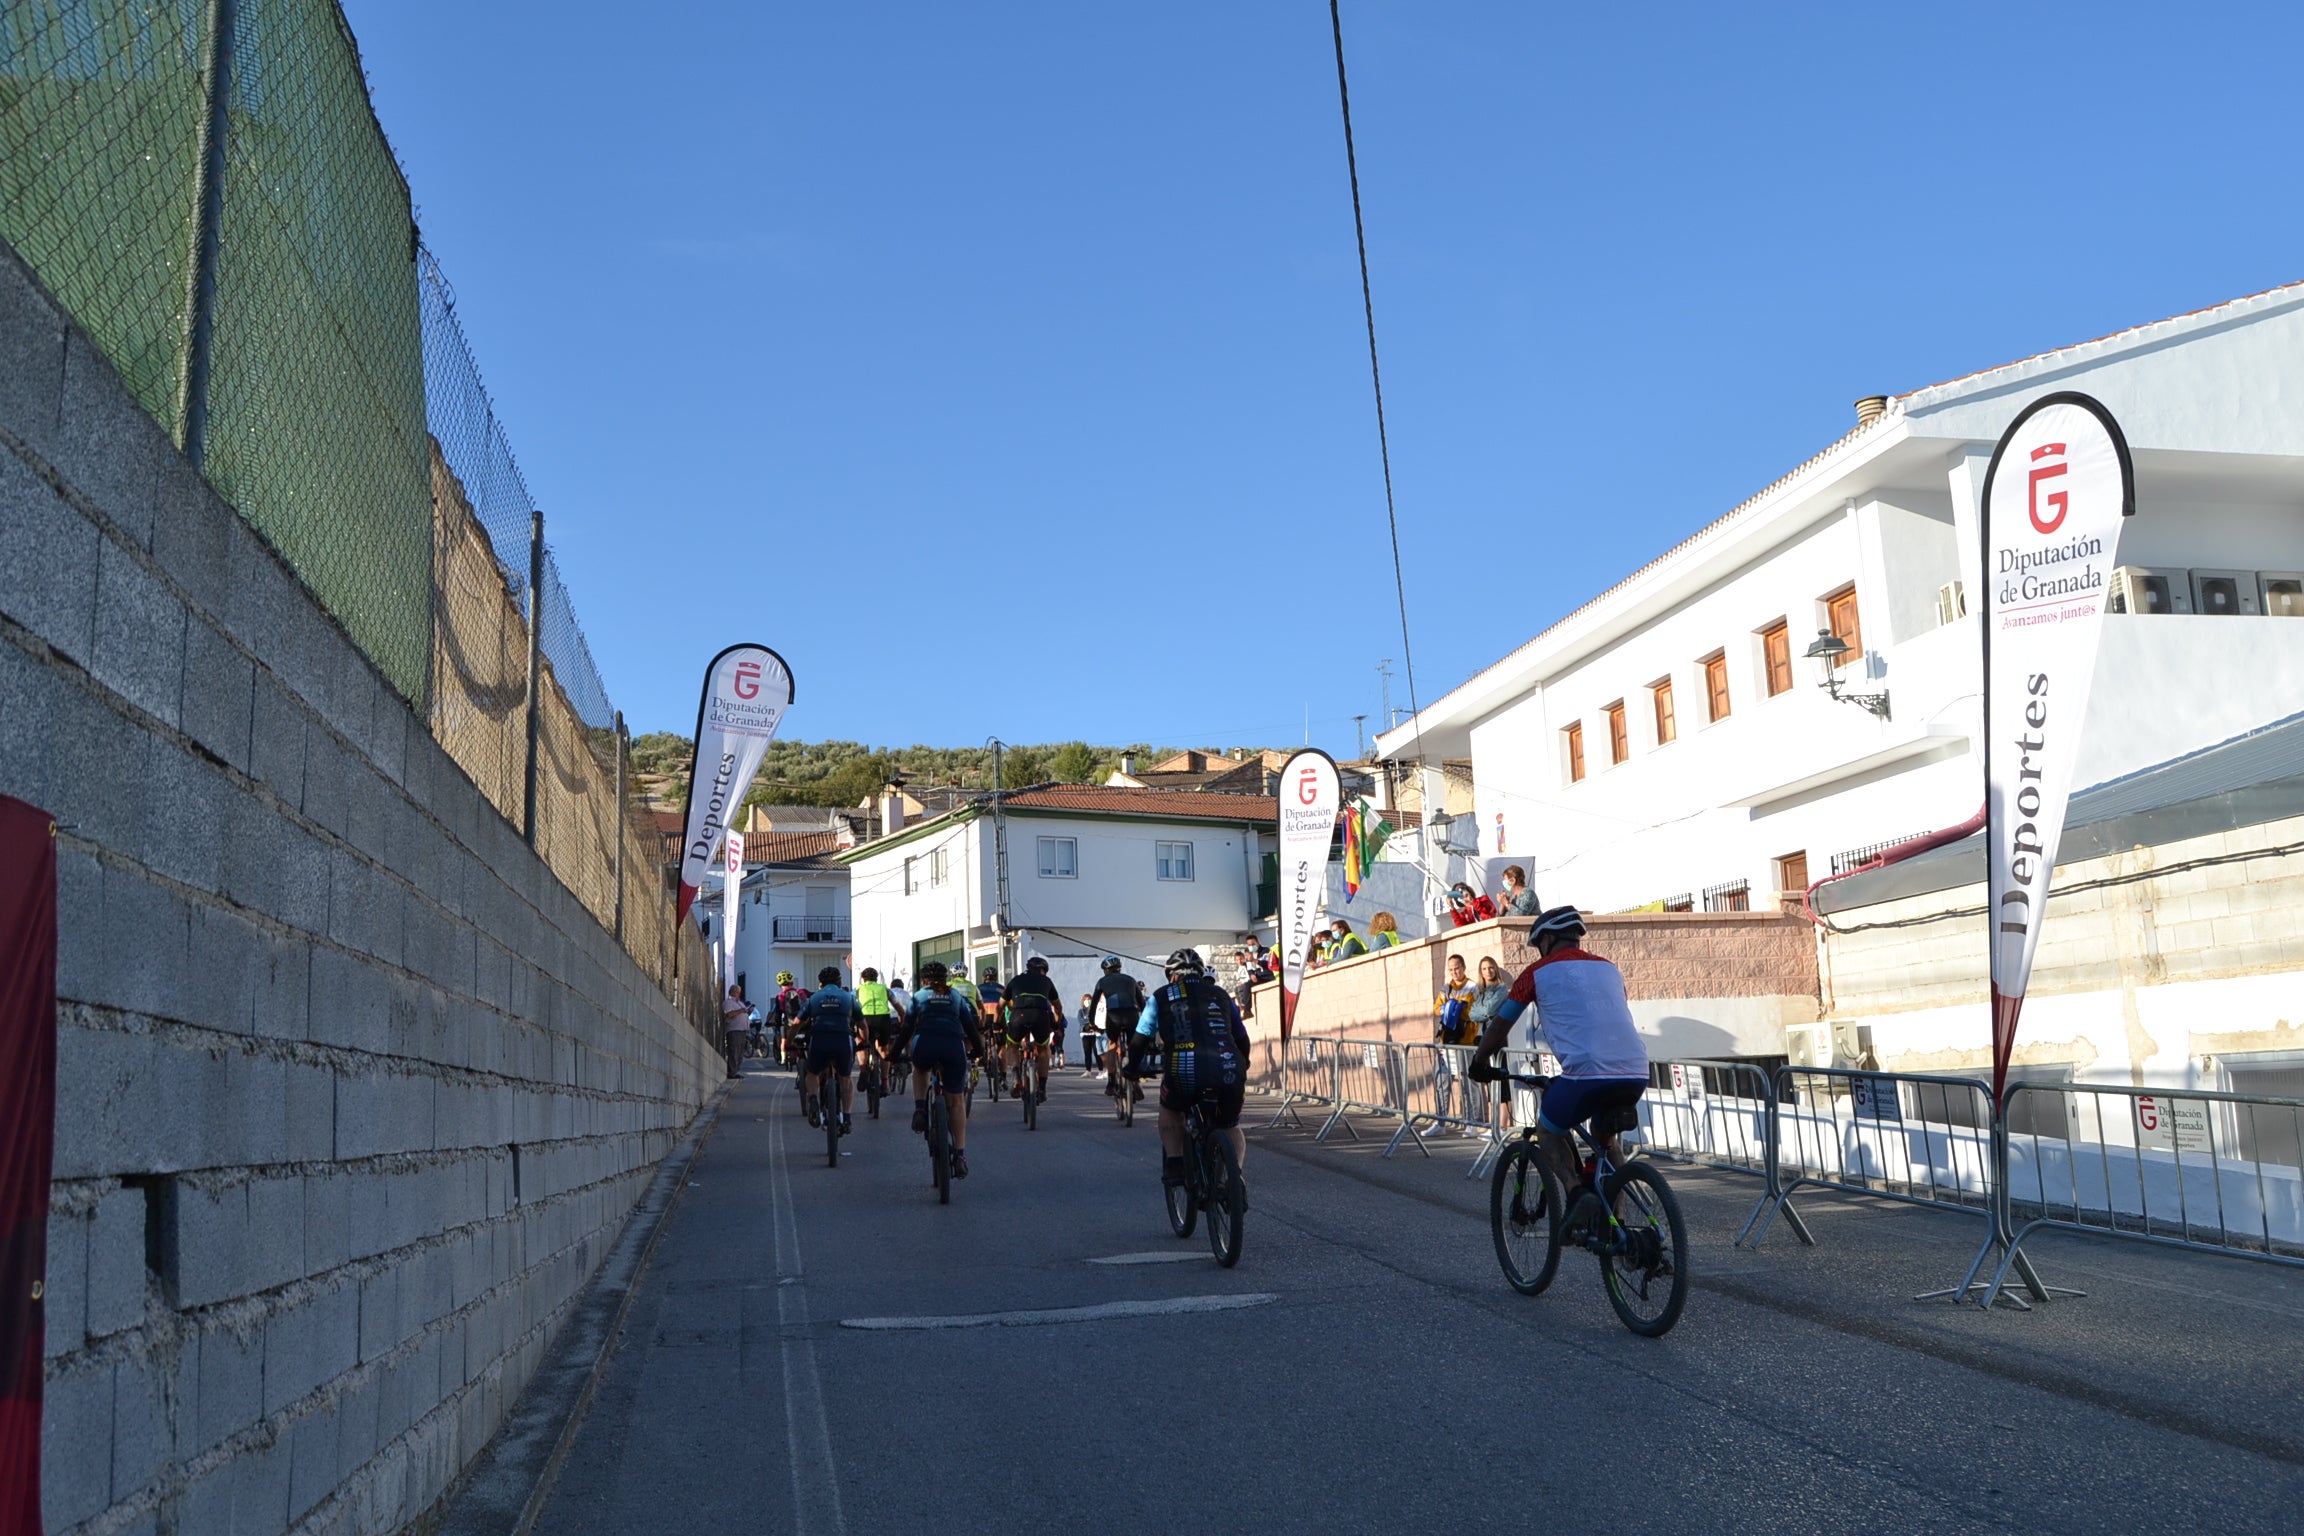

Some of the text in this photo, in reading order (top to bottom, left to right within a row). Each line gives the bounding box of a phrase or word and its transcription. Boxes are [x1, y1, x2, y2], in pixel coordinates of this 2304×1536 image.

[1999, 534, 2102, 575] Diputación
[2000, 563, 2102, 605] de Granada
[2002, 605, 2096, 630] Avanzamos junt@s
[712, 696, 775, 715] Diputación
[710, 710, 774, 728] de Granada
[689, 753, 735, 863] Deportes
[1285, 807, 1331, 821] Diputación
[2000, 673, 2049, 937] Deportes
[1285, 818, 1331, 831] de Granada
[1287, 860, 1308, 968] Deportes
[2160, 1118, 2169, 1128] de
